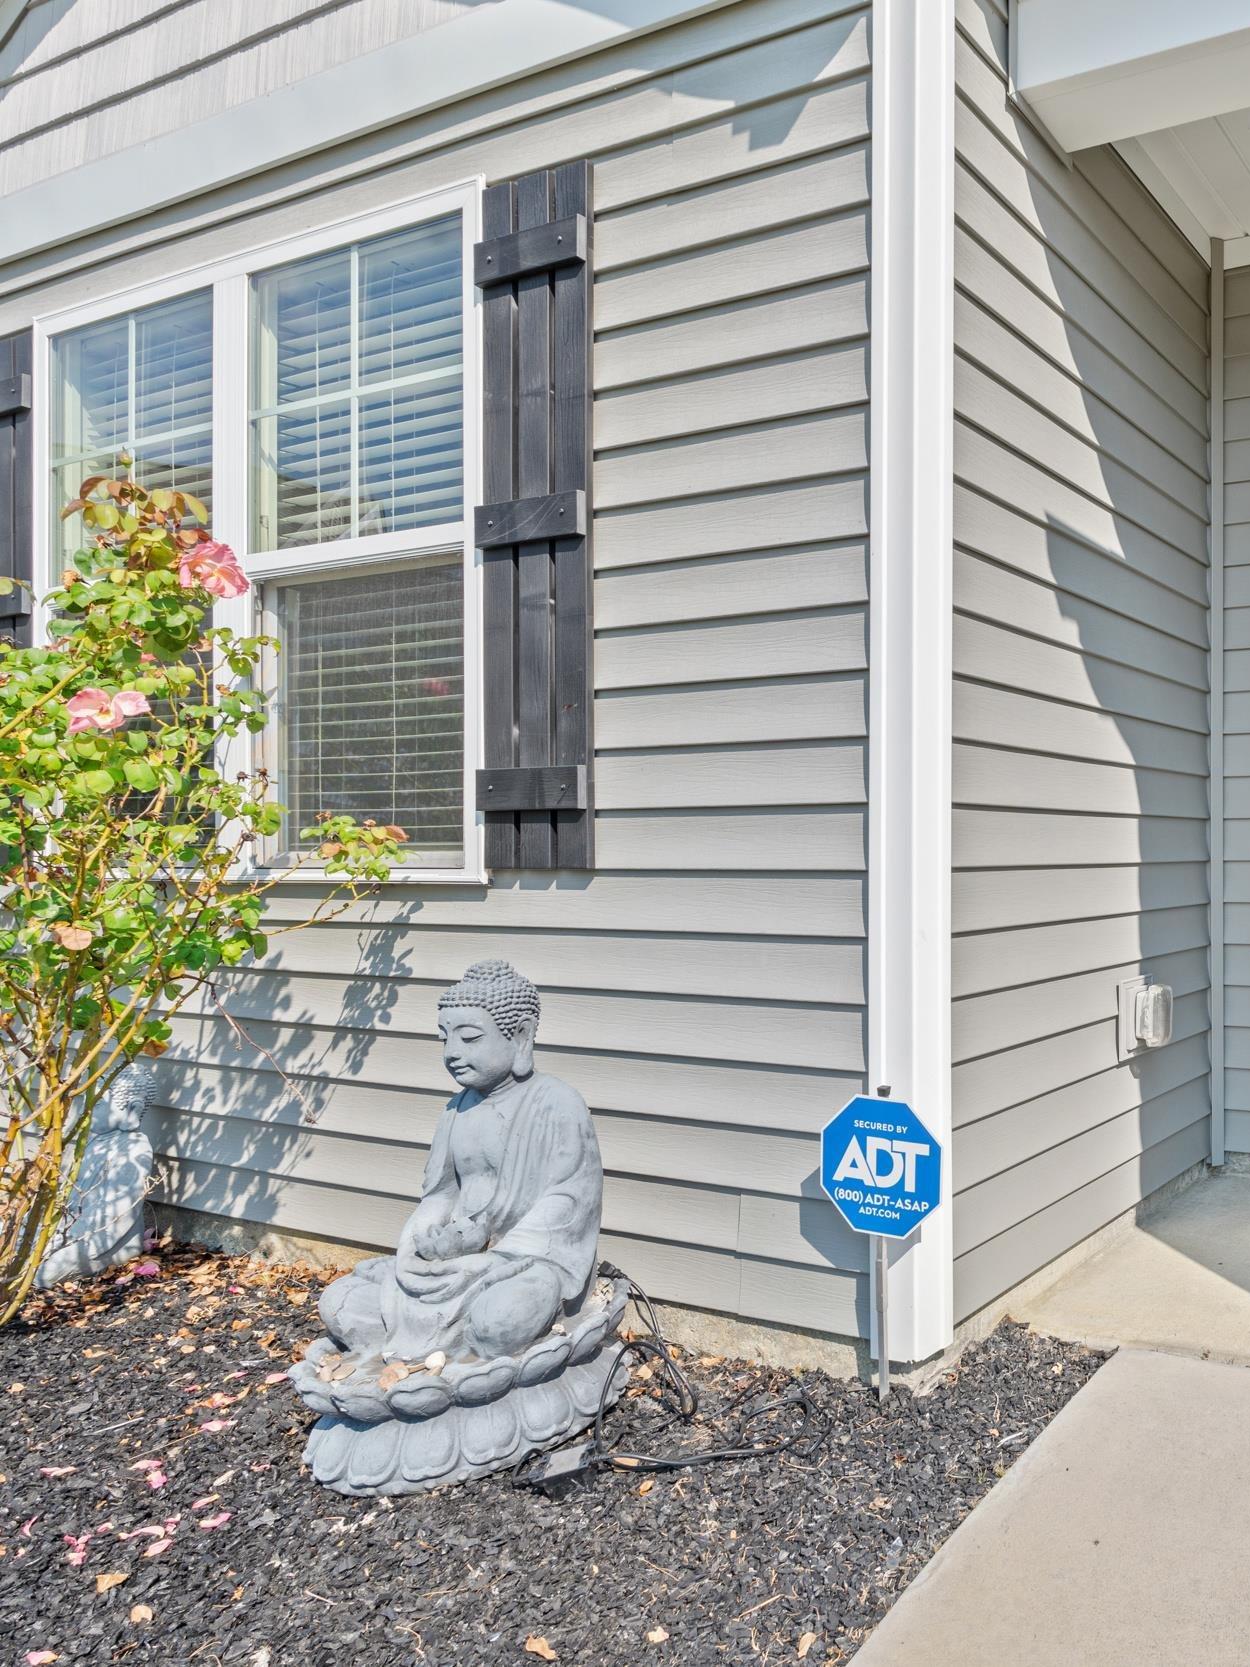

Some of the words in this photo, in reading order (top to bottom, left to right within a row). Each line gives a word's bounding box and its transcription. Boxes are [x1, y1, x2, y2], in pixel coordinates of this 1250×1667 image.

[853, 1119, 894, 1133] SECURED
[896, 1125, 908, 1134] BY
[832, 1134, 930, 1193] ADT
[834, 1186, 864, 1205] (800)
[864, 1193, 930, 1213] ADT-ASAP
[858, 1206, 901, 1220] ADT.COM
